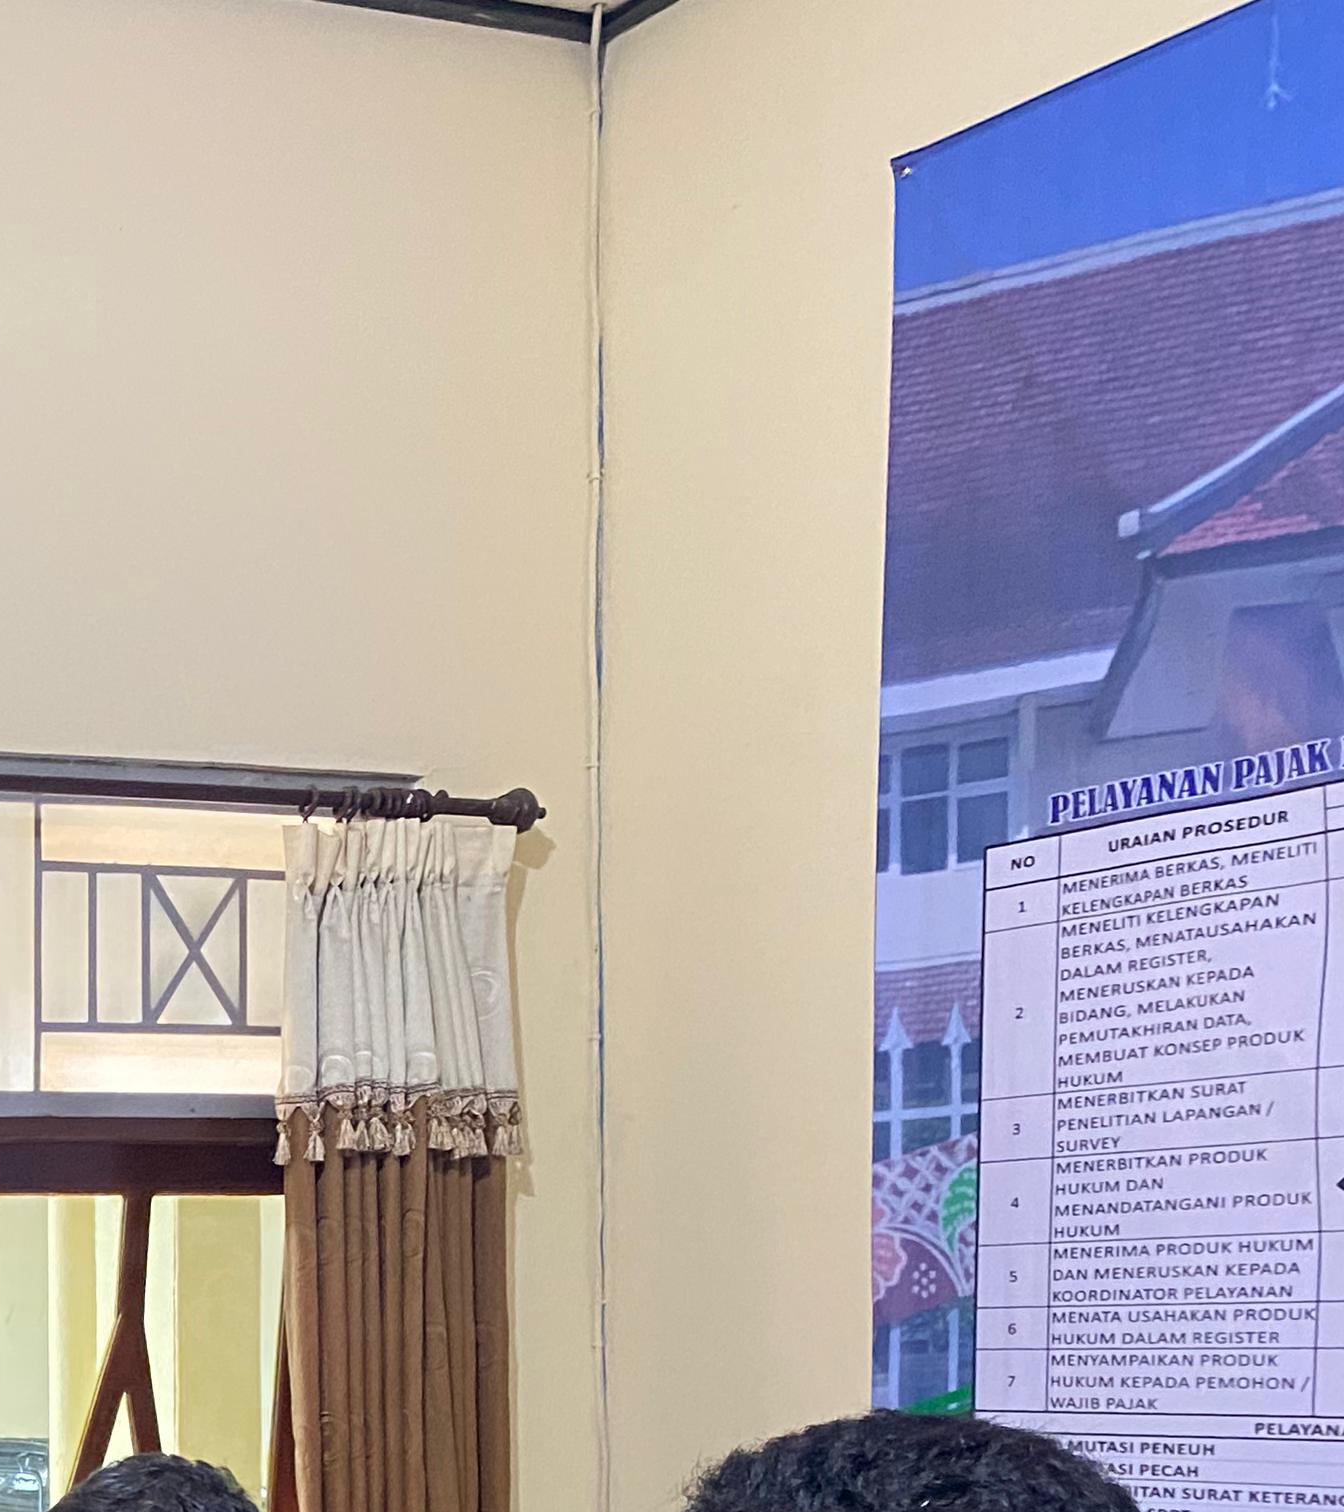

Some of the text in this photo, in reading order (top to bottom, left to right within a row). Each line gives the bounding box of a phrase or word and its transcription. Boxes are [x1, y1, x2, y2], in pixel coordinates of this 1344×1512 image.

[1050, 740, 1328, 823] PELAYANAN PAJAK
[1108, 811, 1288, 852] URAIAN PROSEDUR
[1011, 855, 1035, 871] NO
[1064, 841, 1317, 894] MENERIMA BERKAS, MENELITI
[1063, 875, 1247, 916] KELENGKAPAN BERKAS
[1018, 902, 1025, 912] 1
[1062, 894, 1279, 938] MENELITI KELENGKAPAN
[1061, 913, 1316, 960] BERKAS, MENATAUSAHAKAN
[1060, 950, 1212, 981] DALAM REGISTER,
[1060, 966, 1254, 1002] MENERUSKAN KEPADA
[1015, 1008, 1024, 1019] 2
[1059, 990, 1245, 1024] BIDANG, MELAKUKAN
[1059, 1013, 1251, 1046] PEMUTAKHIRAN DATA,
[1058, 1029, 1304, 1067] MEMBUAT KONSEP PRODUK
[1058, 1071, 1123, 1089] HUKUM
[1058, 1081, 1247, 1110] MENERBITKAN SURAT
[1058, 1111, 1156, 1132] PENELITIAN
[1163, 1103, 1261, 1124] LAPANGAN
[1013, 1123, 1020, 1134] 3
[1057, 1137, 1121, 1152] SURVEY
[1057, 1149, 1267, 1175] MENERBITKAN PRODUK
[1056, 1178, 1164, 1196] HUKUM DAN
[1011, 1198, 1018, 1208] 4
[1055, 1192, 1312, 1217] MENANDATANGANI PRODUK
[1054, 1224, 1120, 1238] HUKUM
[1054, 1239, 1314, 1260] MENERIMA PRODUK HUKUM
[1010, 1271, 1017, 1282] 5
[1054, 1262, 1300, 1281] DAN MENERUSKAN KEPADA
[1053, 1285, 1293, 1303] KOORDINATOR PELAYANAN
[1052, 1308, 1316, 1323] MENATA USAHAKAN PRODUK
[1008, 1323, 1016, 1335] 6
[1052, 1331, 1280, 1346] HUKUM DALAM REGISTER
[1052, 1354, 1278, 1367] MENYAMPAIKAN PRODUK
[1008, 1376, 1015, 1387] 7
[1051, 1376, 1113, 1388] HUKUM
[1121, 1376, 1189, 1389] KEPADA
[1196, 1377, 1294, 1390] PEMOHON
[1050, 1397, 1157, 1410] WAJIB PAJAK
[1254, 1423, 1344, 1437] PELAYAN
[1067, 1440, 1215, 1456] MUTASI PENEUH
[1140, 1465, 1199, 1477] PECAH
[1181, 1490, 1242, 1501] SURAT
